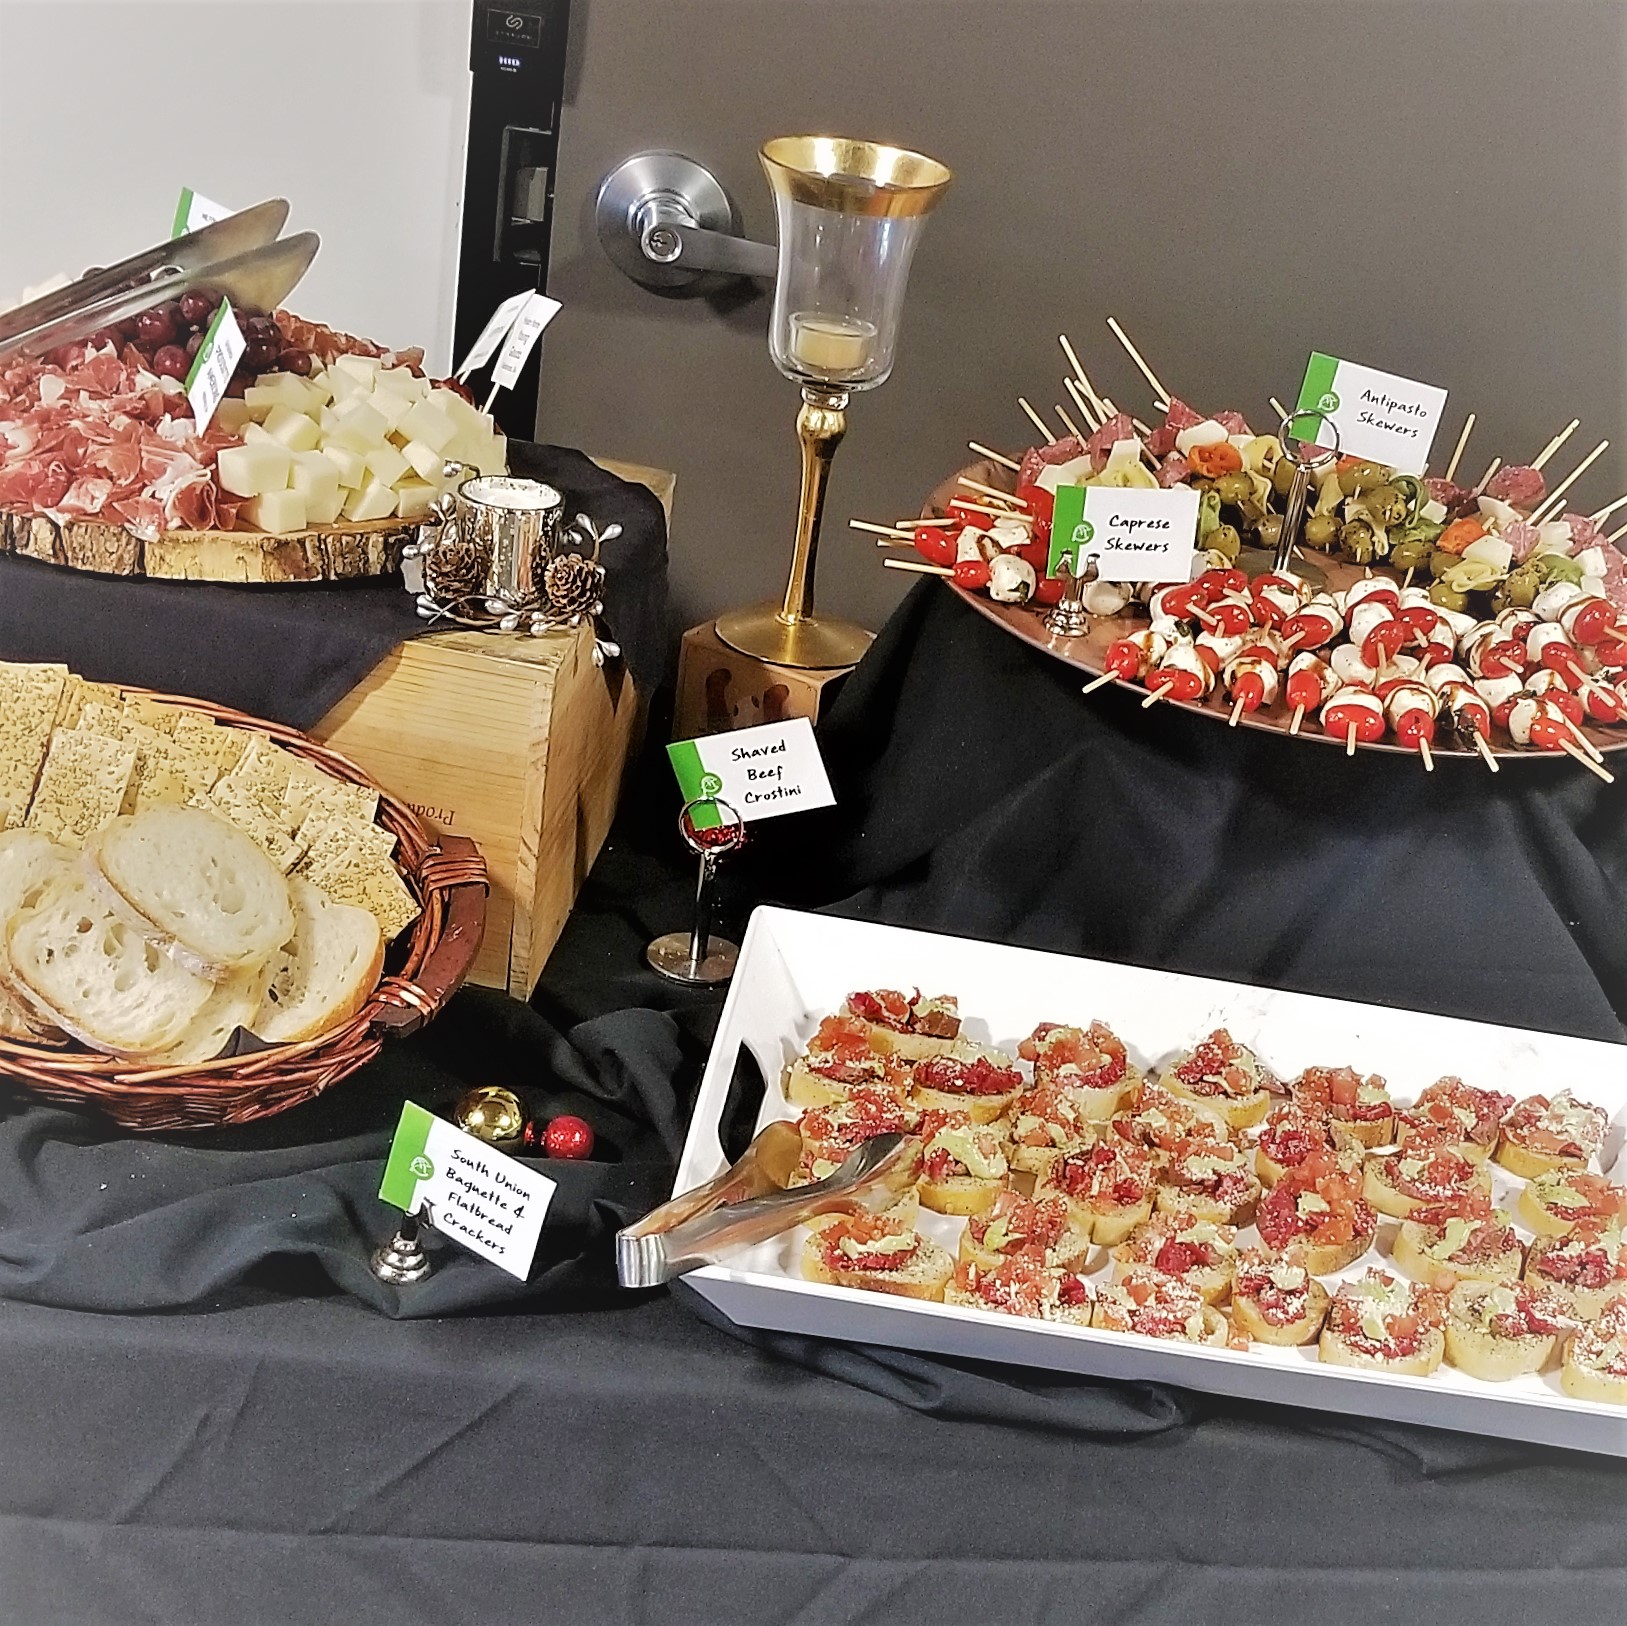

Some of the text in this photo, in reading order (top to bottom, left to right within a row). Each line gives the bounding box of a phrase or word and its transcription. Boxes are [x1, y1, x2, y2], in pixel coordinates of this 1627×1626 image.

[1360, 389, 1427, 418] Antipasto
[1357, 411, 1418, 438] Skewers
[1109, 515, 1170, 533] Caprese
[1105, 538, 1169, 552] Skewers
[732, 739, 786, 761] Shaved
[747, 766, 783, 780] Beef
[745, 785, 801, 803] Crostini
[451, 1149, 530, 1201] South Union
[446, 1167, 525, 1218] Baguette &
[448, 1192, 514, 1235] Flatbread
[443, 1213, 506, 1254] Crackers
